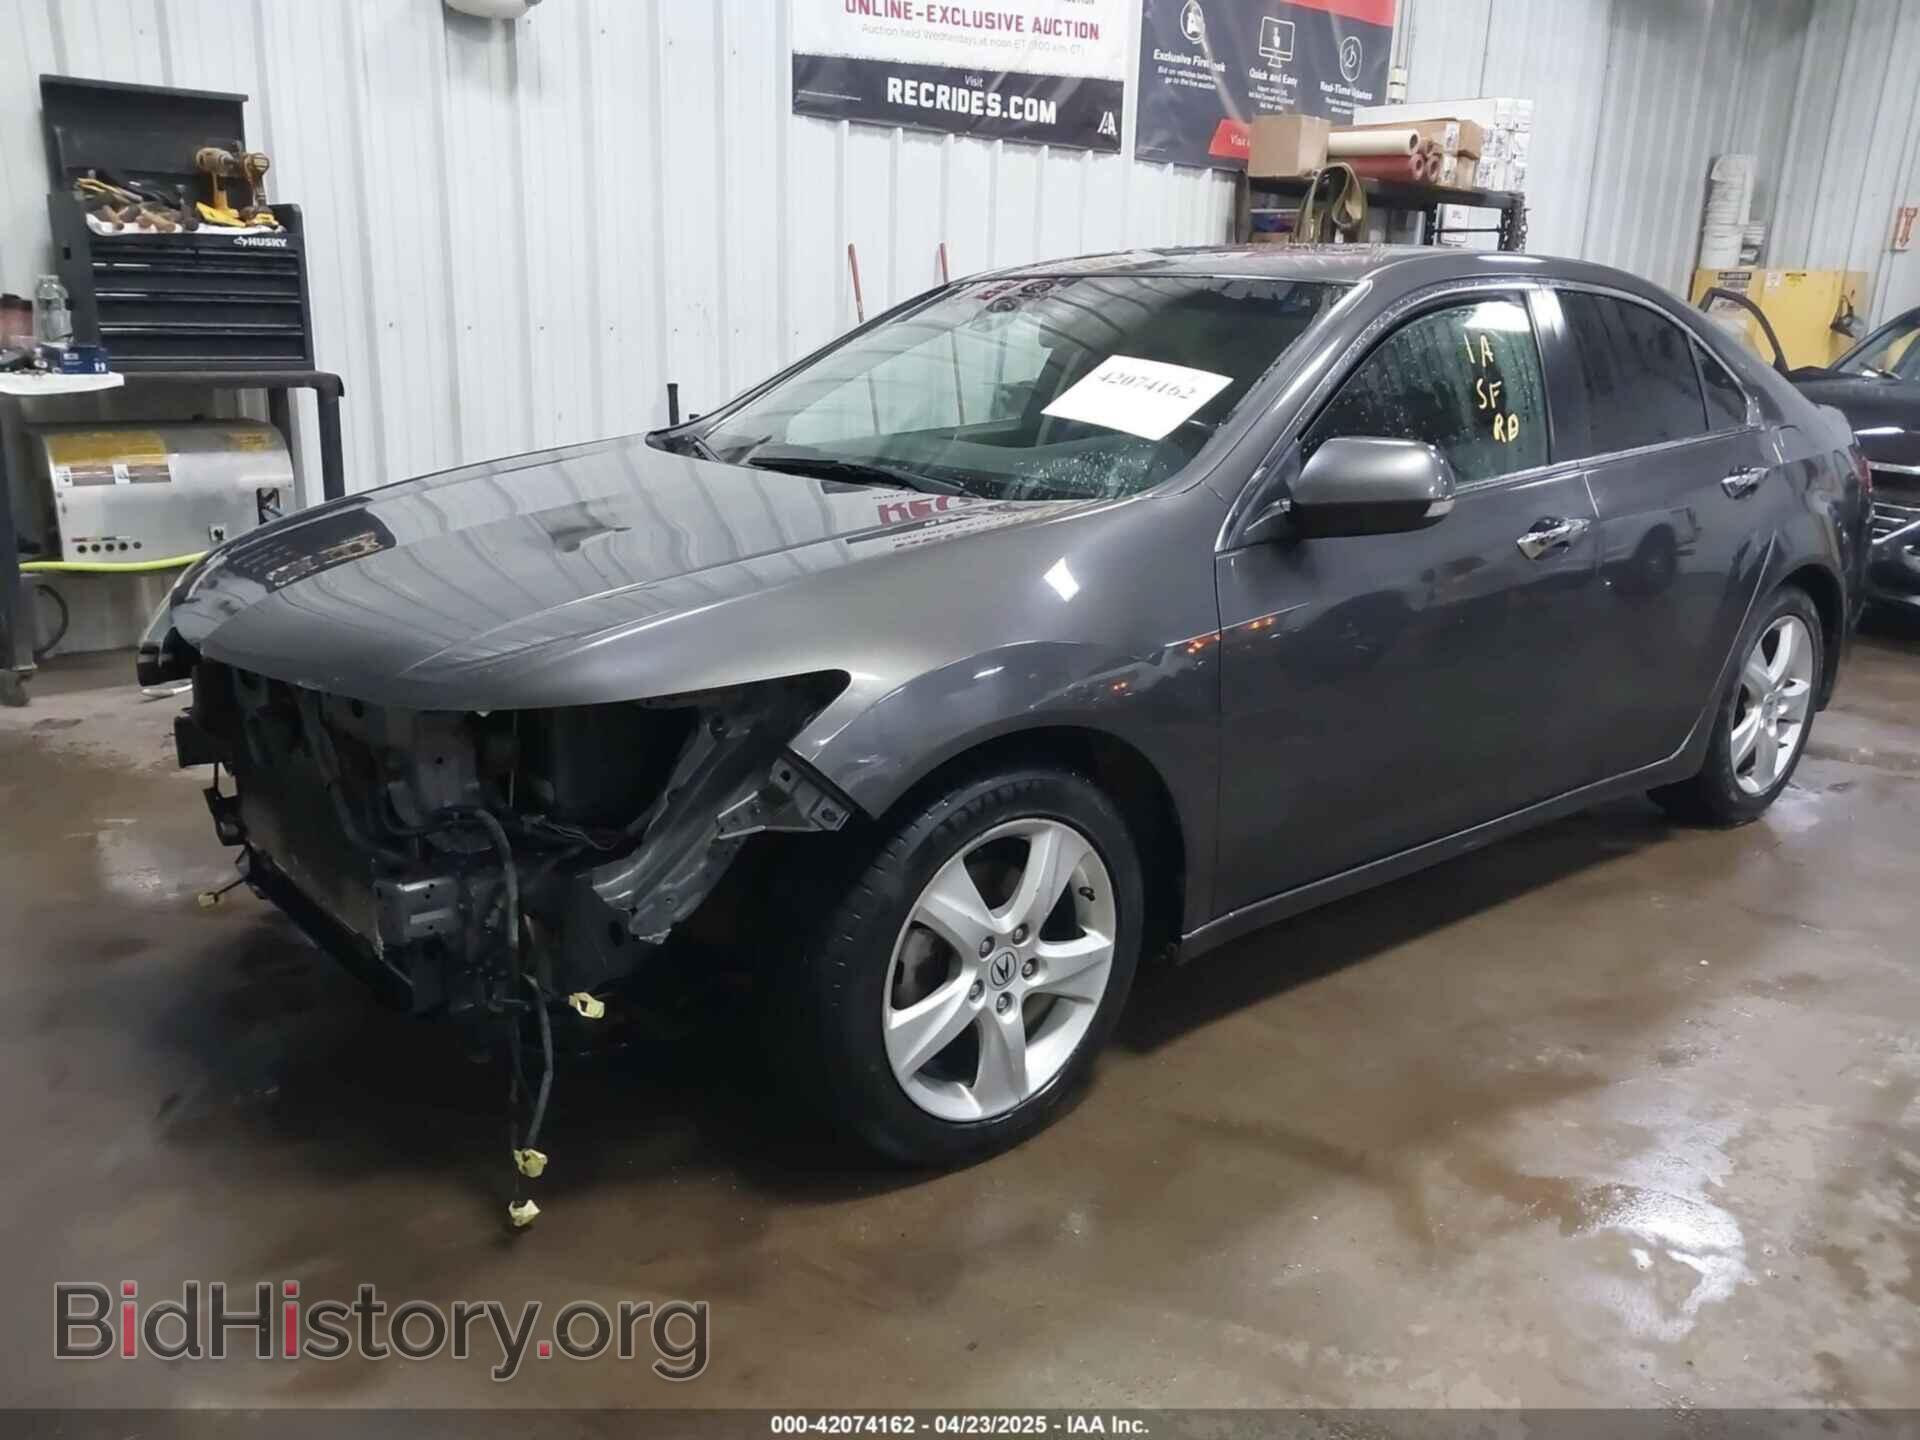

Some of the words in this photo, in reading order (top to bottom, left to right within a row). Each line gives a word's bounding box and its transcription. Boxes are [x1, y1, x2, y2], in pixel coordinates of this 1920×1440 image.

[845, 0, 1025, 33] ONLINE-EXCLUSIVE
[1032, 16, 1100, 41] AUCTION
[1153, 48, 1192, 65] Exclusive
[964, 74, 984, 88] Visit
[1248, 67, 1268, 81] Quick
[1269, 73, 1282, 84] and
[1282, 74, 1298, 87] Easy
[886, 77, 1058, 125] RECRIDES.COM
[248, 236, 287, 248] HUSKY
[1099, 361, 1197, 400] 42074162
[1476, 377, 1502, 409] SF
